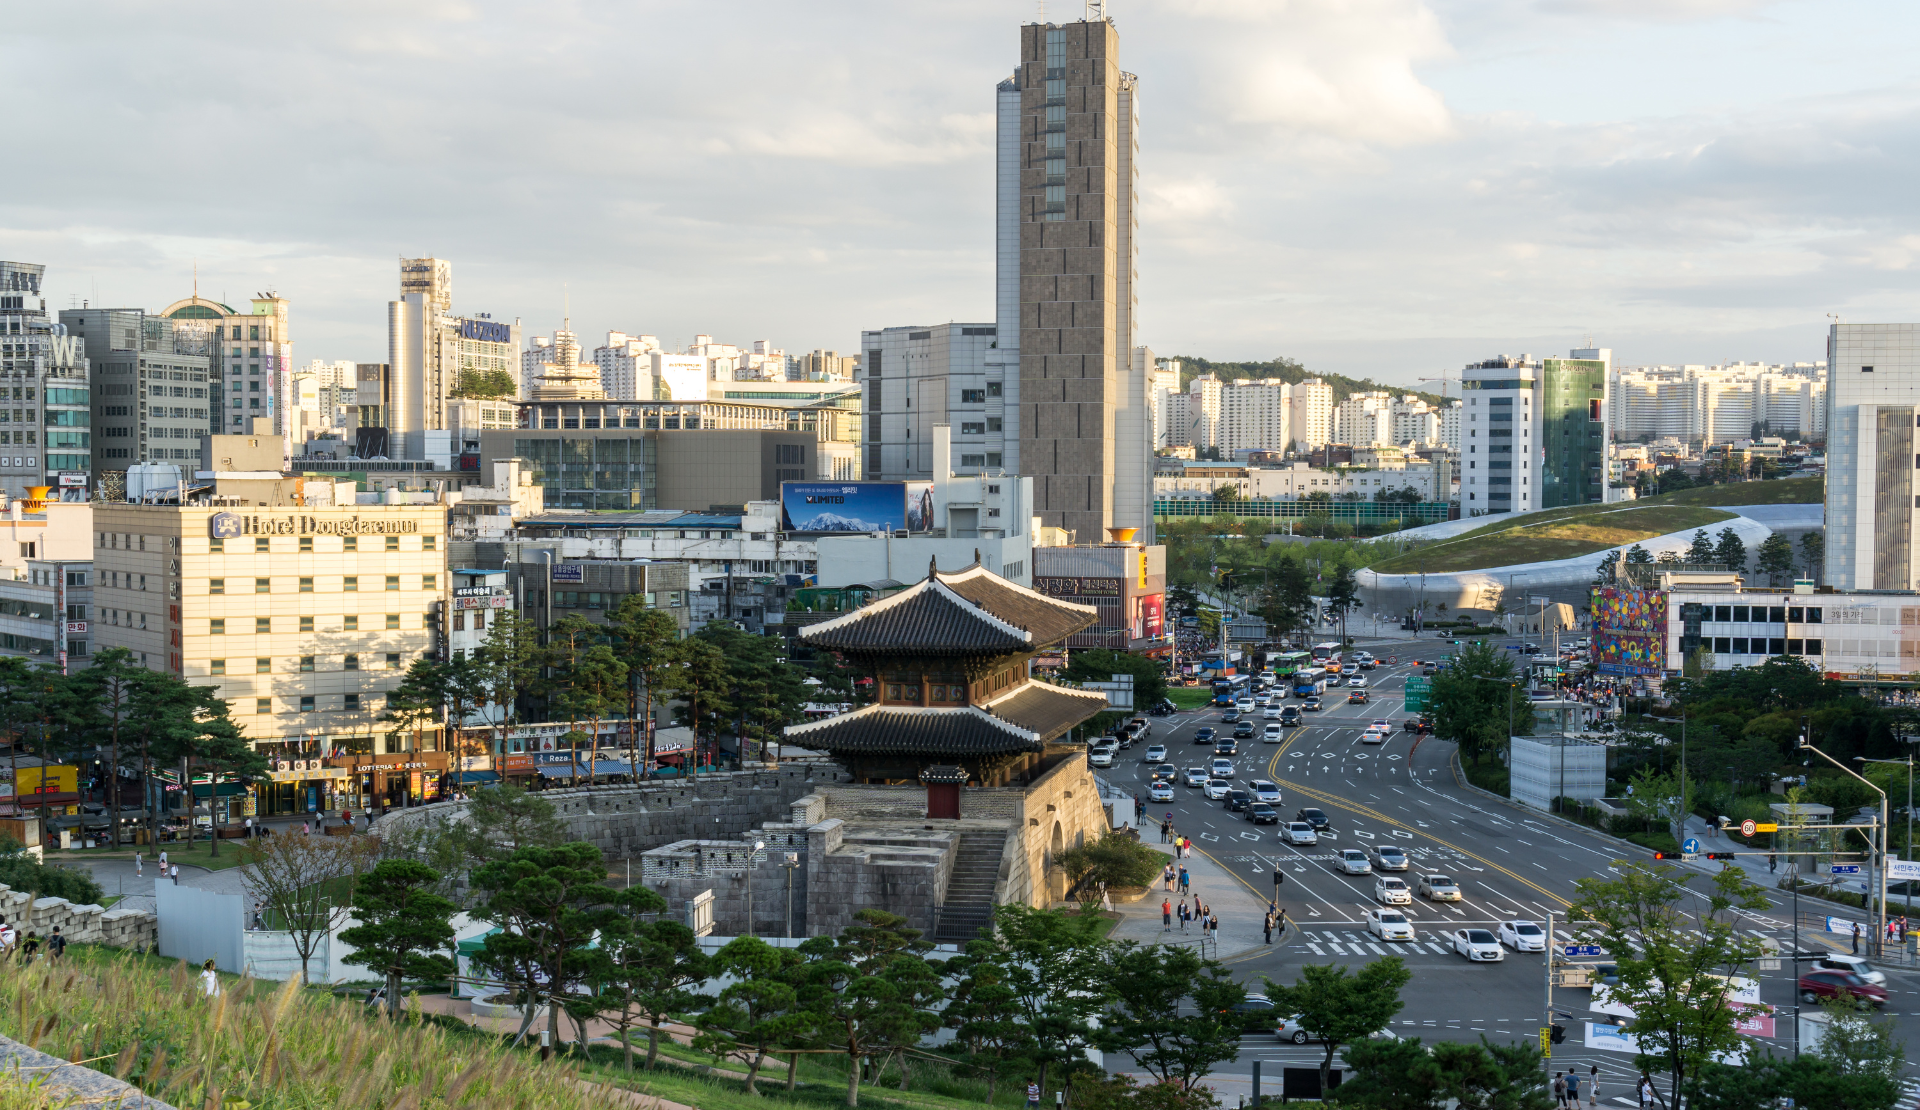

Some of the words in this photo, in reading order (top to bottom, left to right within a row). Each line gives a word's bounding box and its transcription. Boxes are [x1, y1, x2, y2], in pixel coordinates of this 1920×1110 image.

[461, 319, 510, 343] NUZZON
[51, 335, 77, 366] W
[813, 496, 845, 504] LIMITED
[246, 515, 297, 535] Hotel
[302, 515, 419, 537] Dongdaemun
[67, 623, 86, 632] 만화
